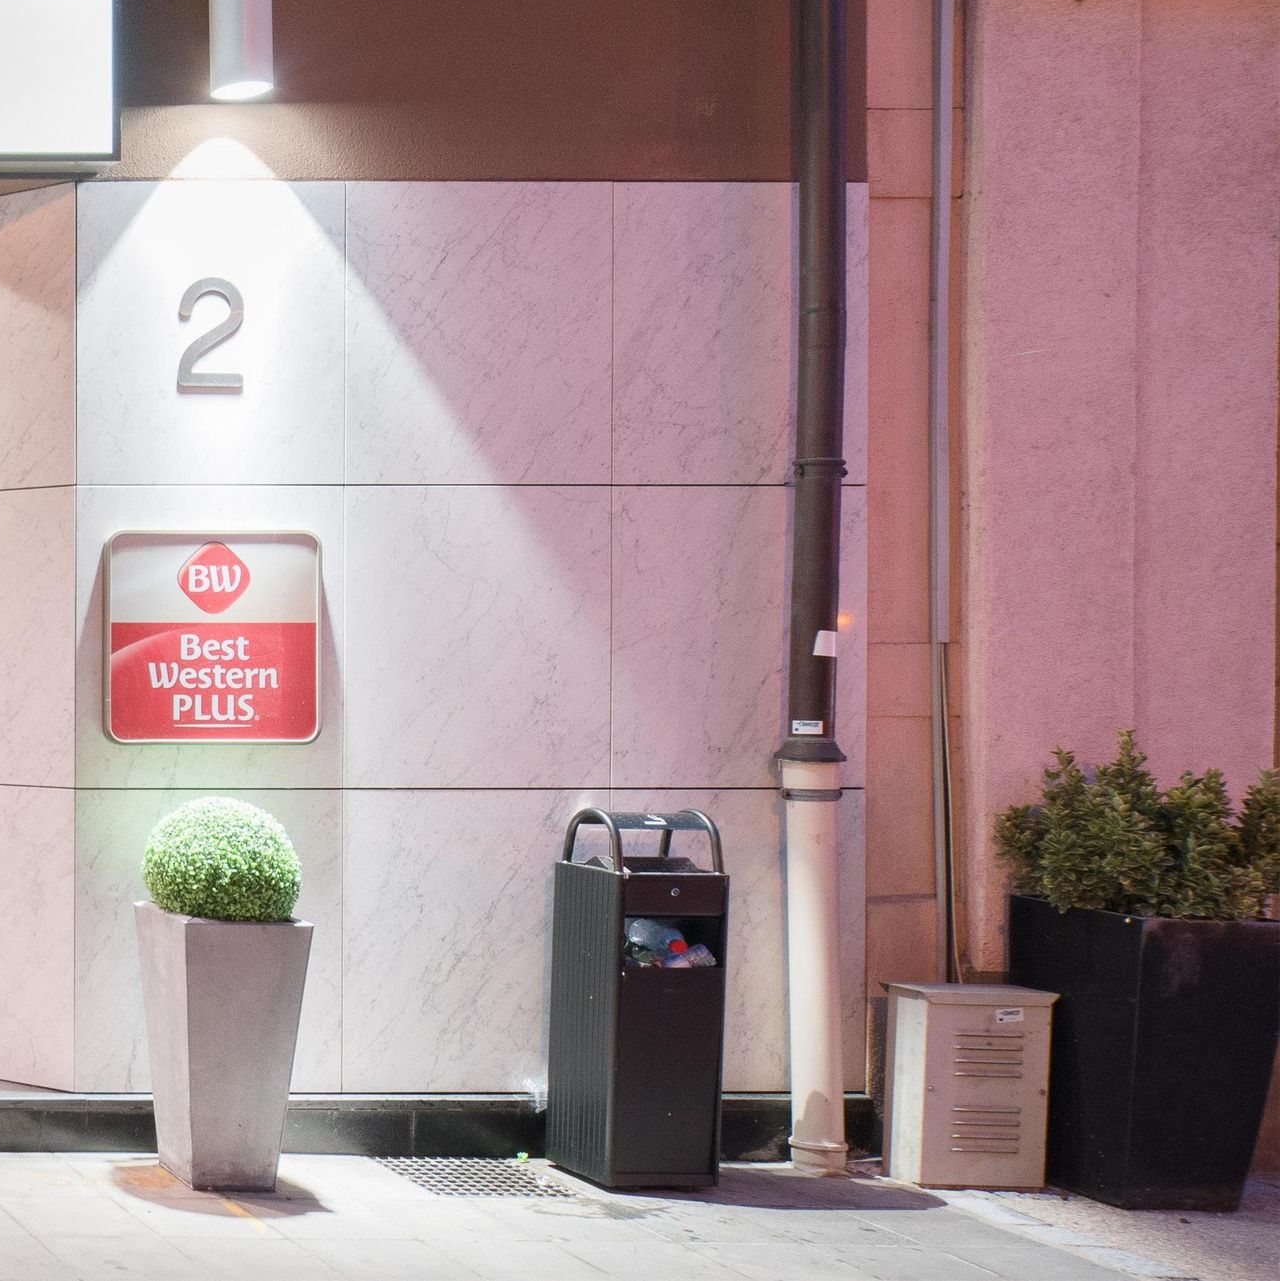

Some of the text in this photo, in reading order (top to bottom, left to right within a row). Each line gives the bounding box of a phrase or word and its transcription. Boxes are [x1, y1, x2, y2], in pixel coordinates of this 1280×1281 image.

[177, 276, 244, 395] 2
[189, 564, 243, 593] BW
[180, 633, 251, 661] Best
[147, 662, 280, 689] Western
